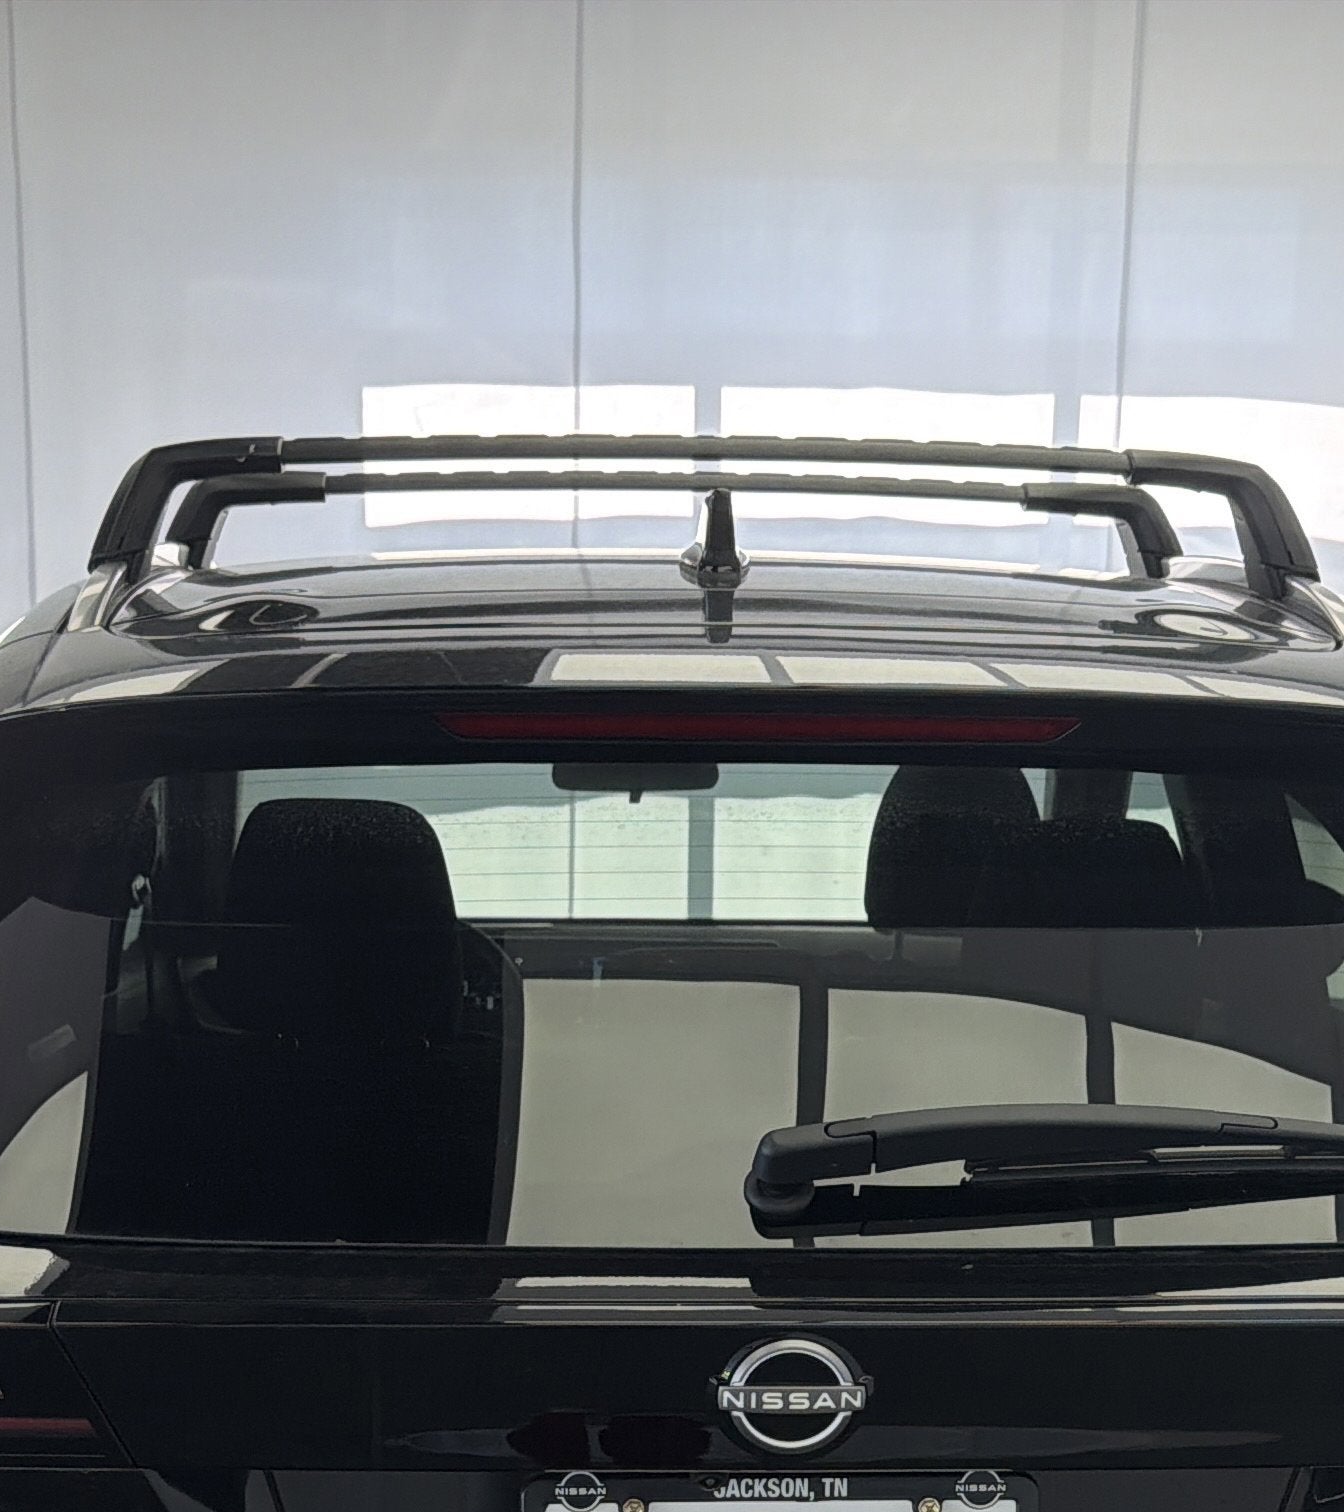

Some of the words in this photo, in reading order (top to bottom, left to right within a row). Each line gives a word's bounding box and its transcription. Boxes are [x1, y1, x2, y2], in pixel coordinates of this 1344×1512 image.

[722, 1389, 862, 1411] NISSAN
[555, 1487, 607, 1496] NISSAN
[821, 1477, 848, 1498] TN
[955, 1483, 1007, 1492] NISSAN
